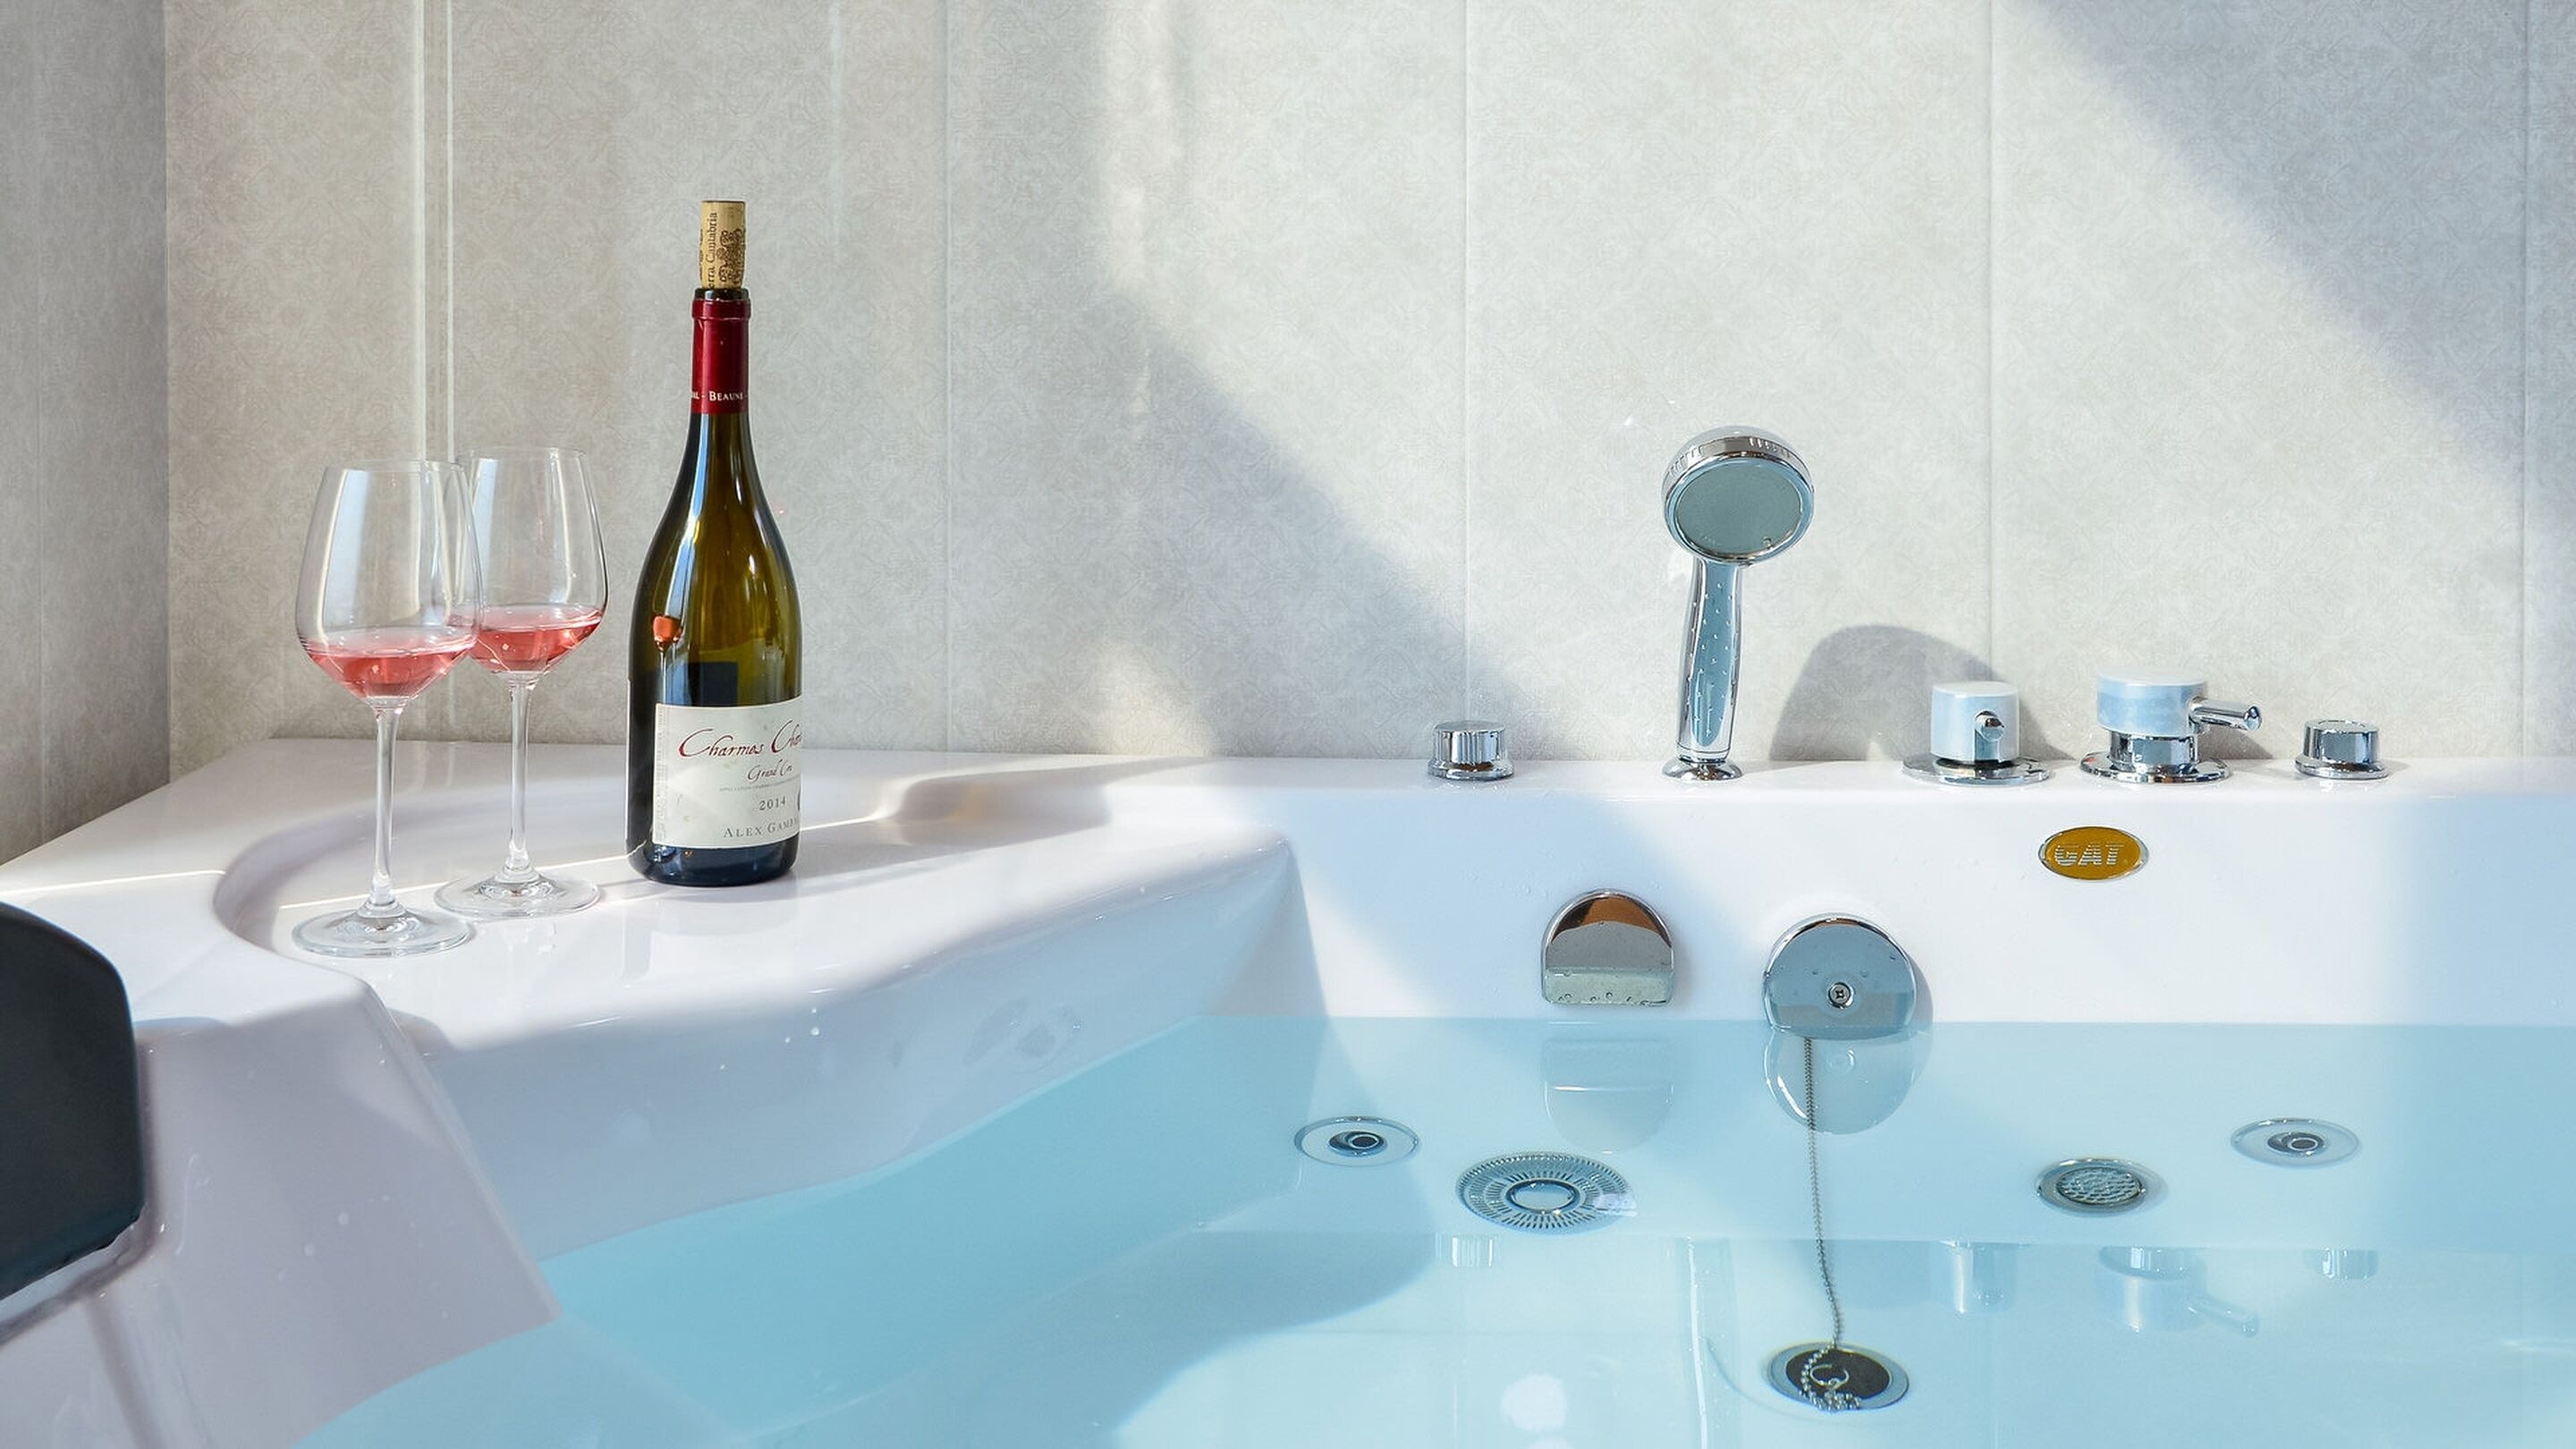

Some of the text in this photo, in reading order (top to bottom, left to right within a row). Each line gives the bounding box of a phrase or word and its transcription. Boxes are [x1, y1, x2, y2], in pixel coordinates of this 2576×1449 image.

[705, 212, 717, 264] Cantabria
[678, 728, 764, 758] Charmes
[758, 795, 786, 811] 2014
[723, 826, 763, 838] ALEX
[2054, 843, 2124, 867] GAT
